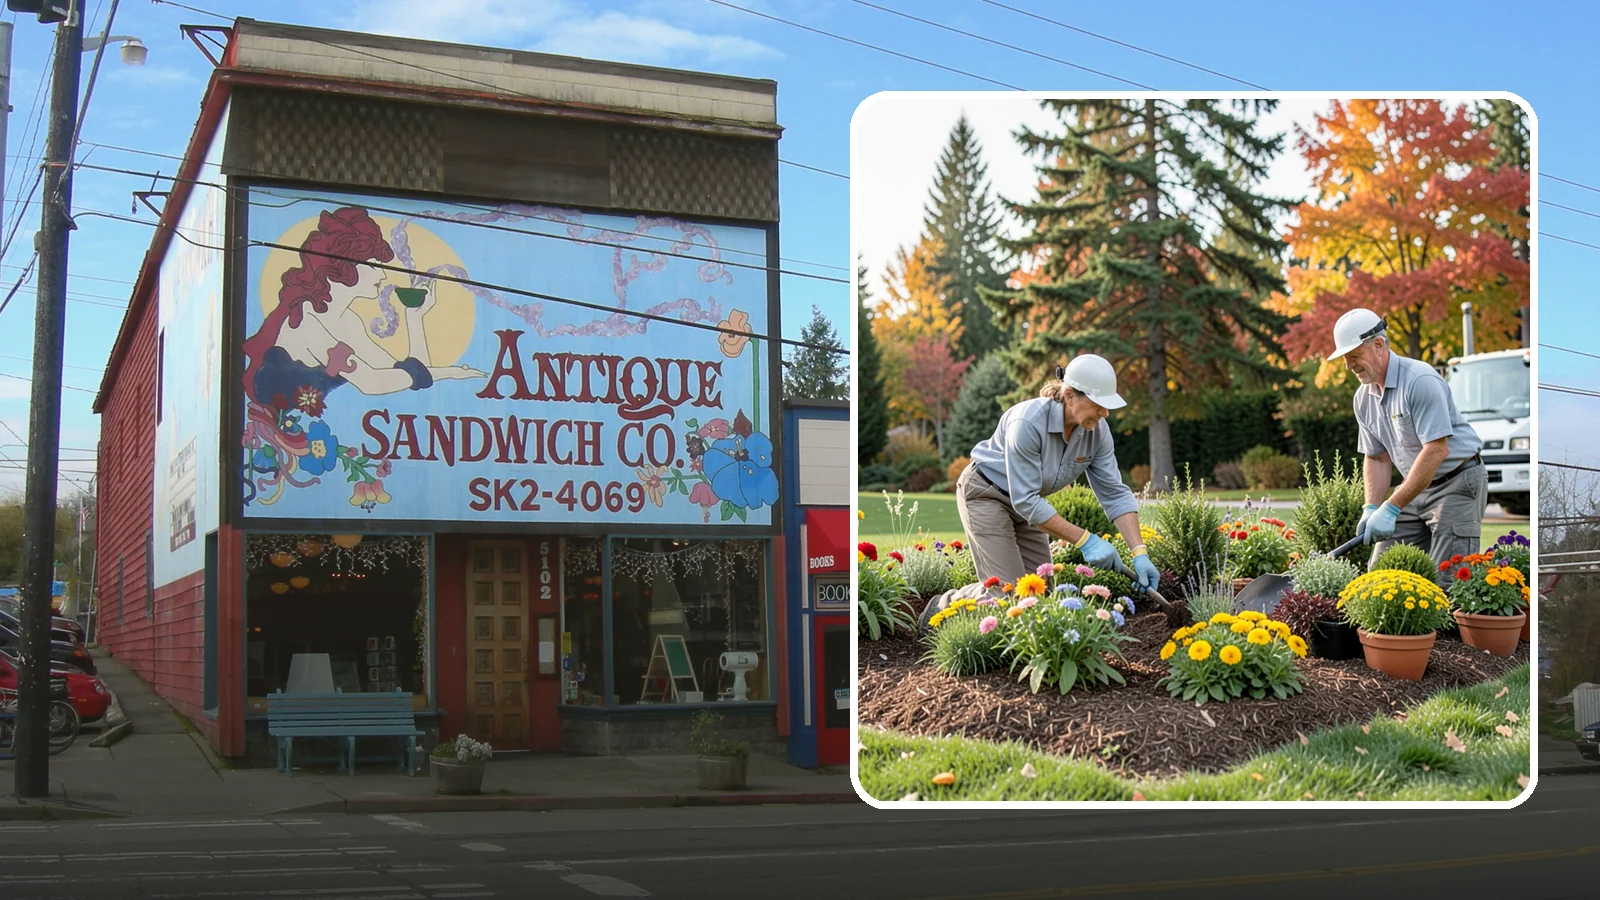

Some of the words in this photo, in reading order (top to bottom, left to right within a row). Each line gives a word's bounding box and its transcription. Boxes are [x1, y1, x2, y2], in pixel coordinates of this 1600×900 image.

[476, 329, 722, 420] ANTIQUE
[361, 409, 604, 467] SANDWICH
[617, 420, 685, 468] CO.
[468, 477, 646, 512] SK2-4069
[539, 541, 552, 600] 5102
[809, 555, 835, 569] BOOKS
